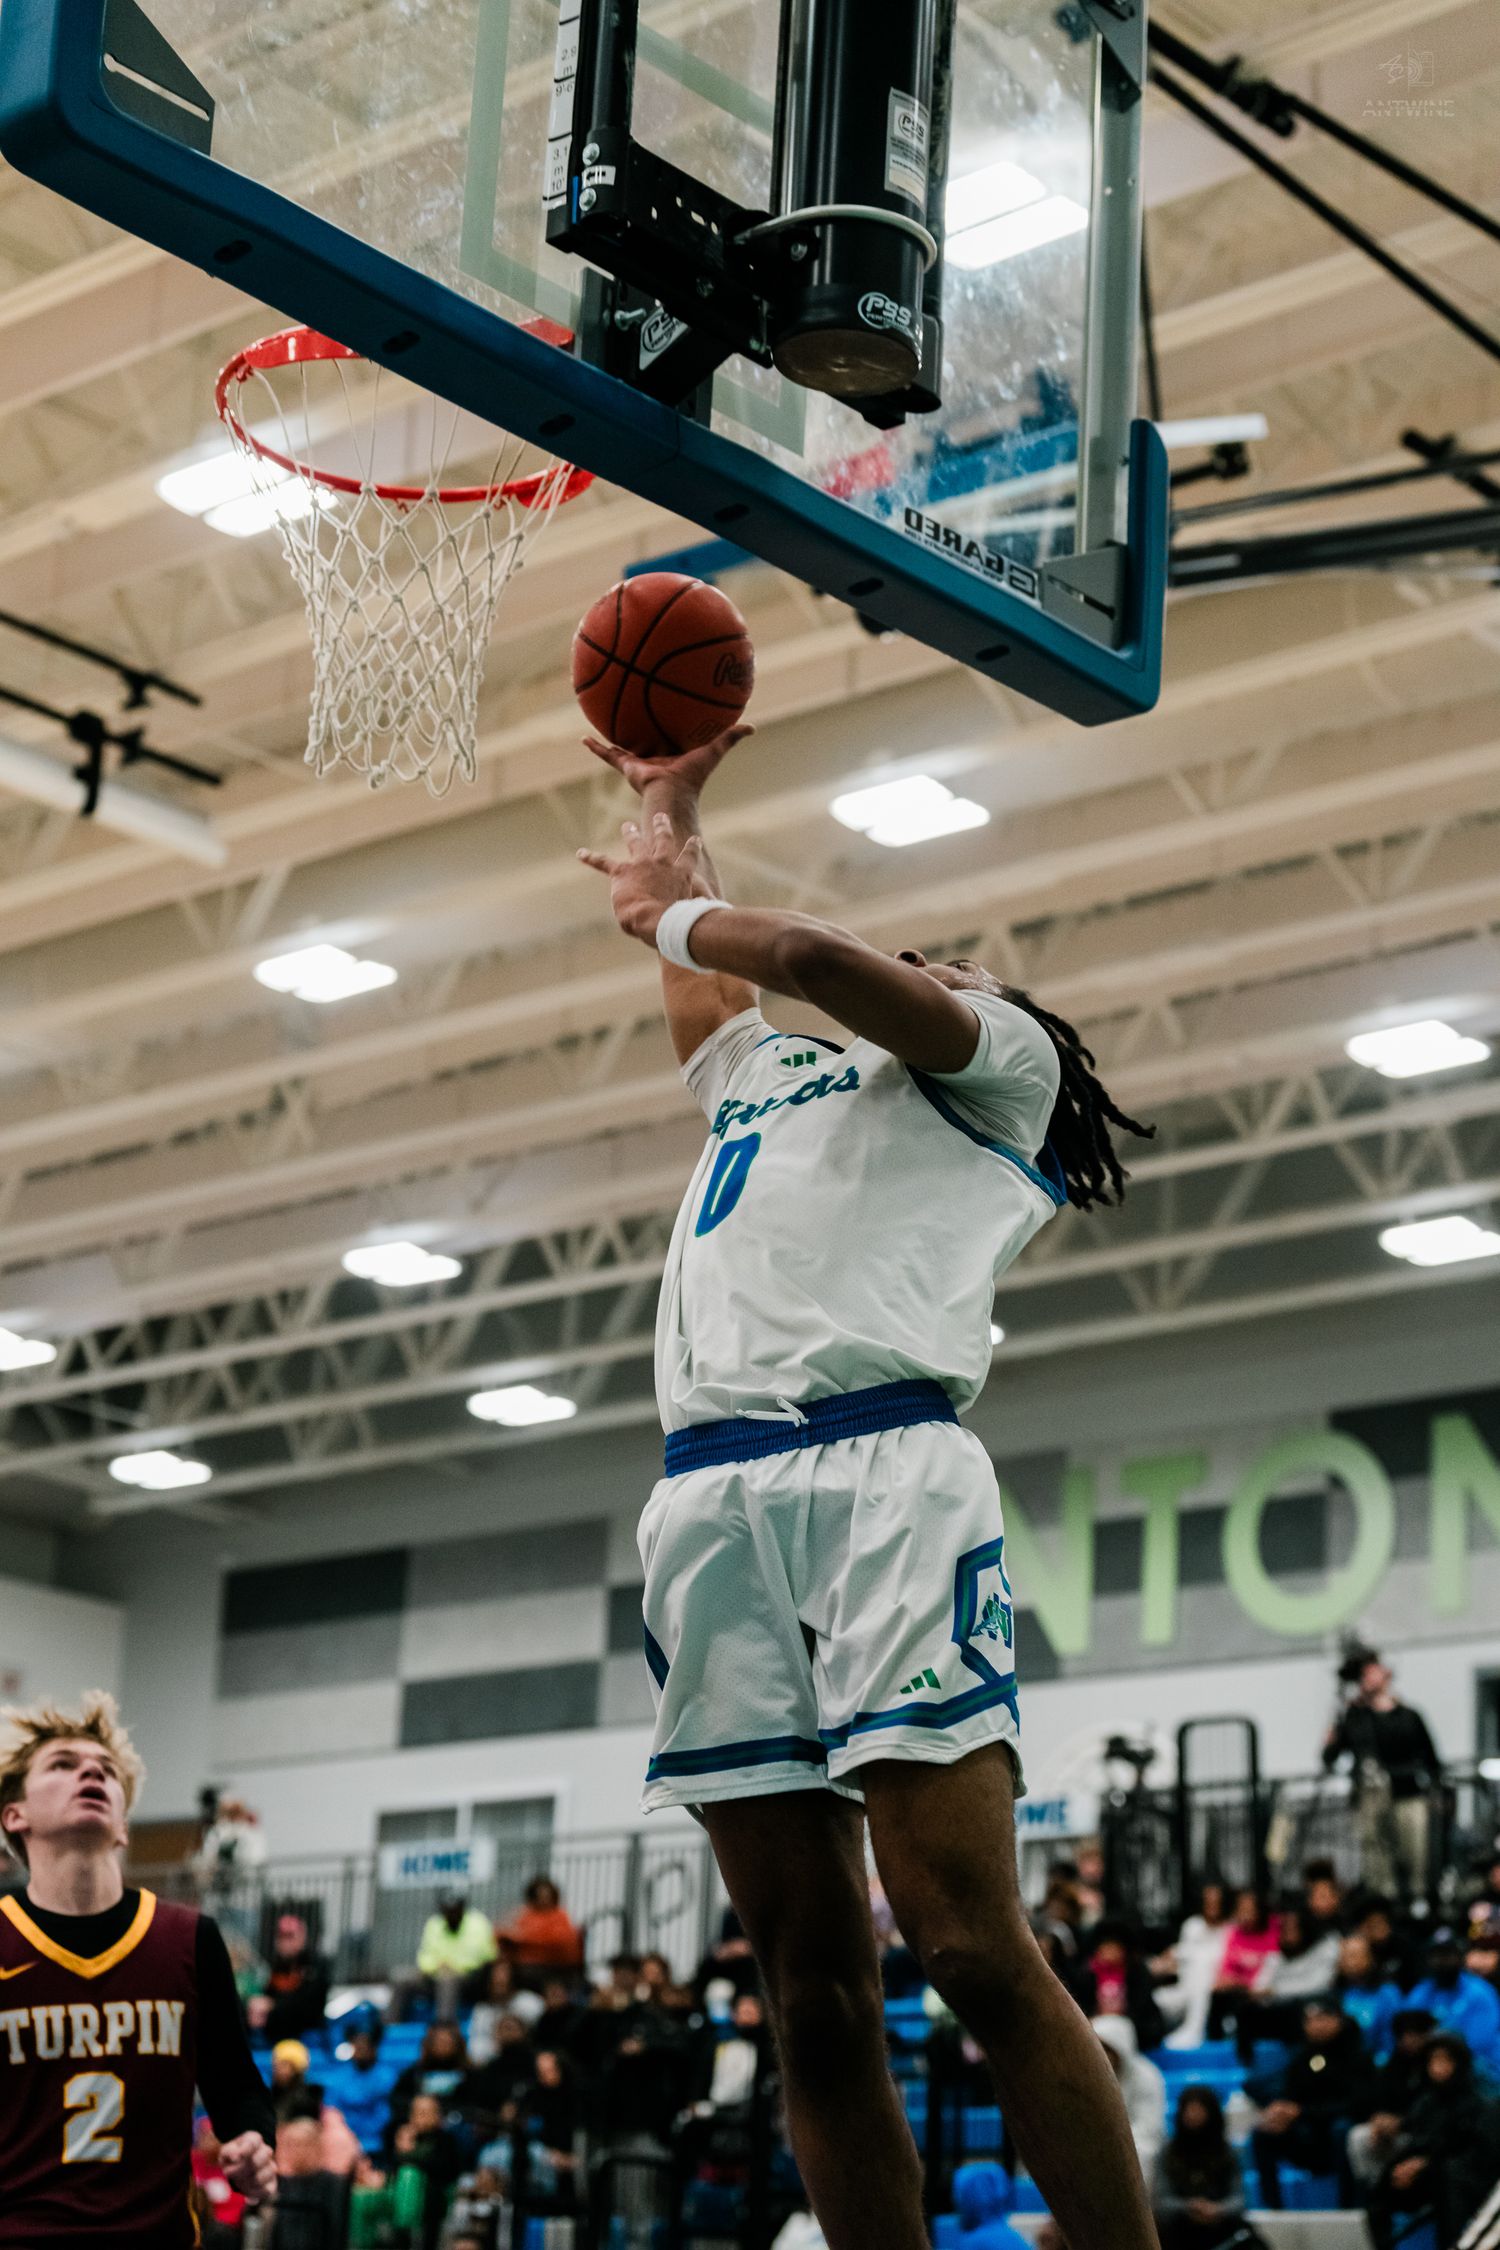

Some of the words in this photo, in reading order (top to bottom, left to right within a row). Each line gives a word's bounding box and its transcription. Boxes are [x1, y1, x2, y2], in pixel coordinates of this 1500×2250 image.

[694, 1132, 762, 1238] 0
[0, 1999, 185, 2065] TURPIN
[62, 2071, 125, 2163] 2
